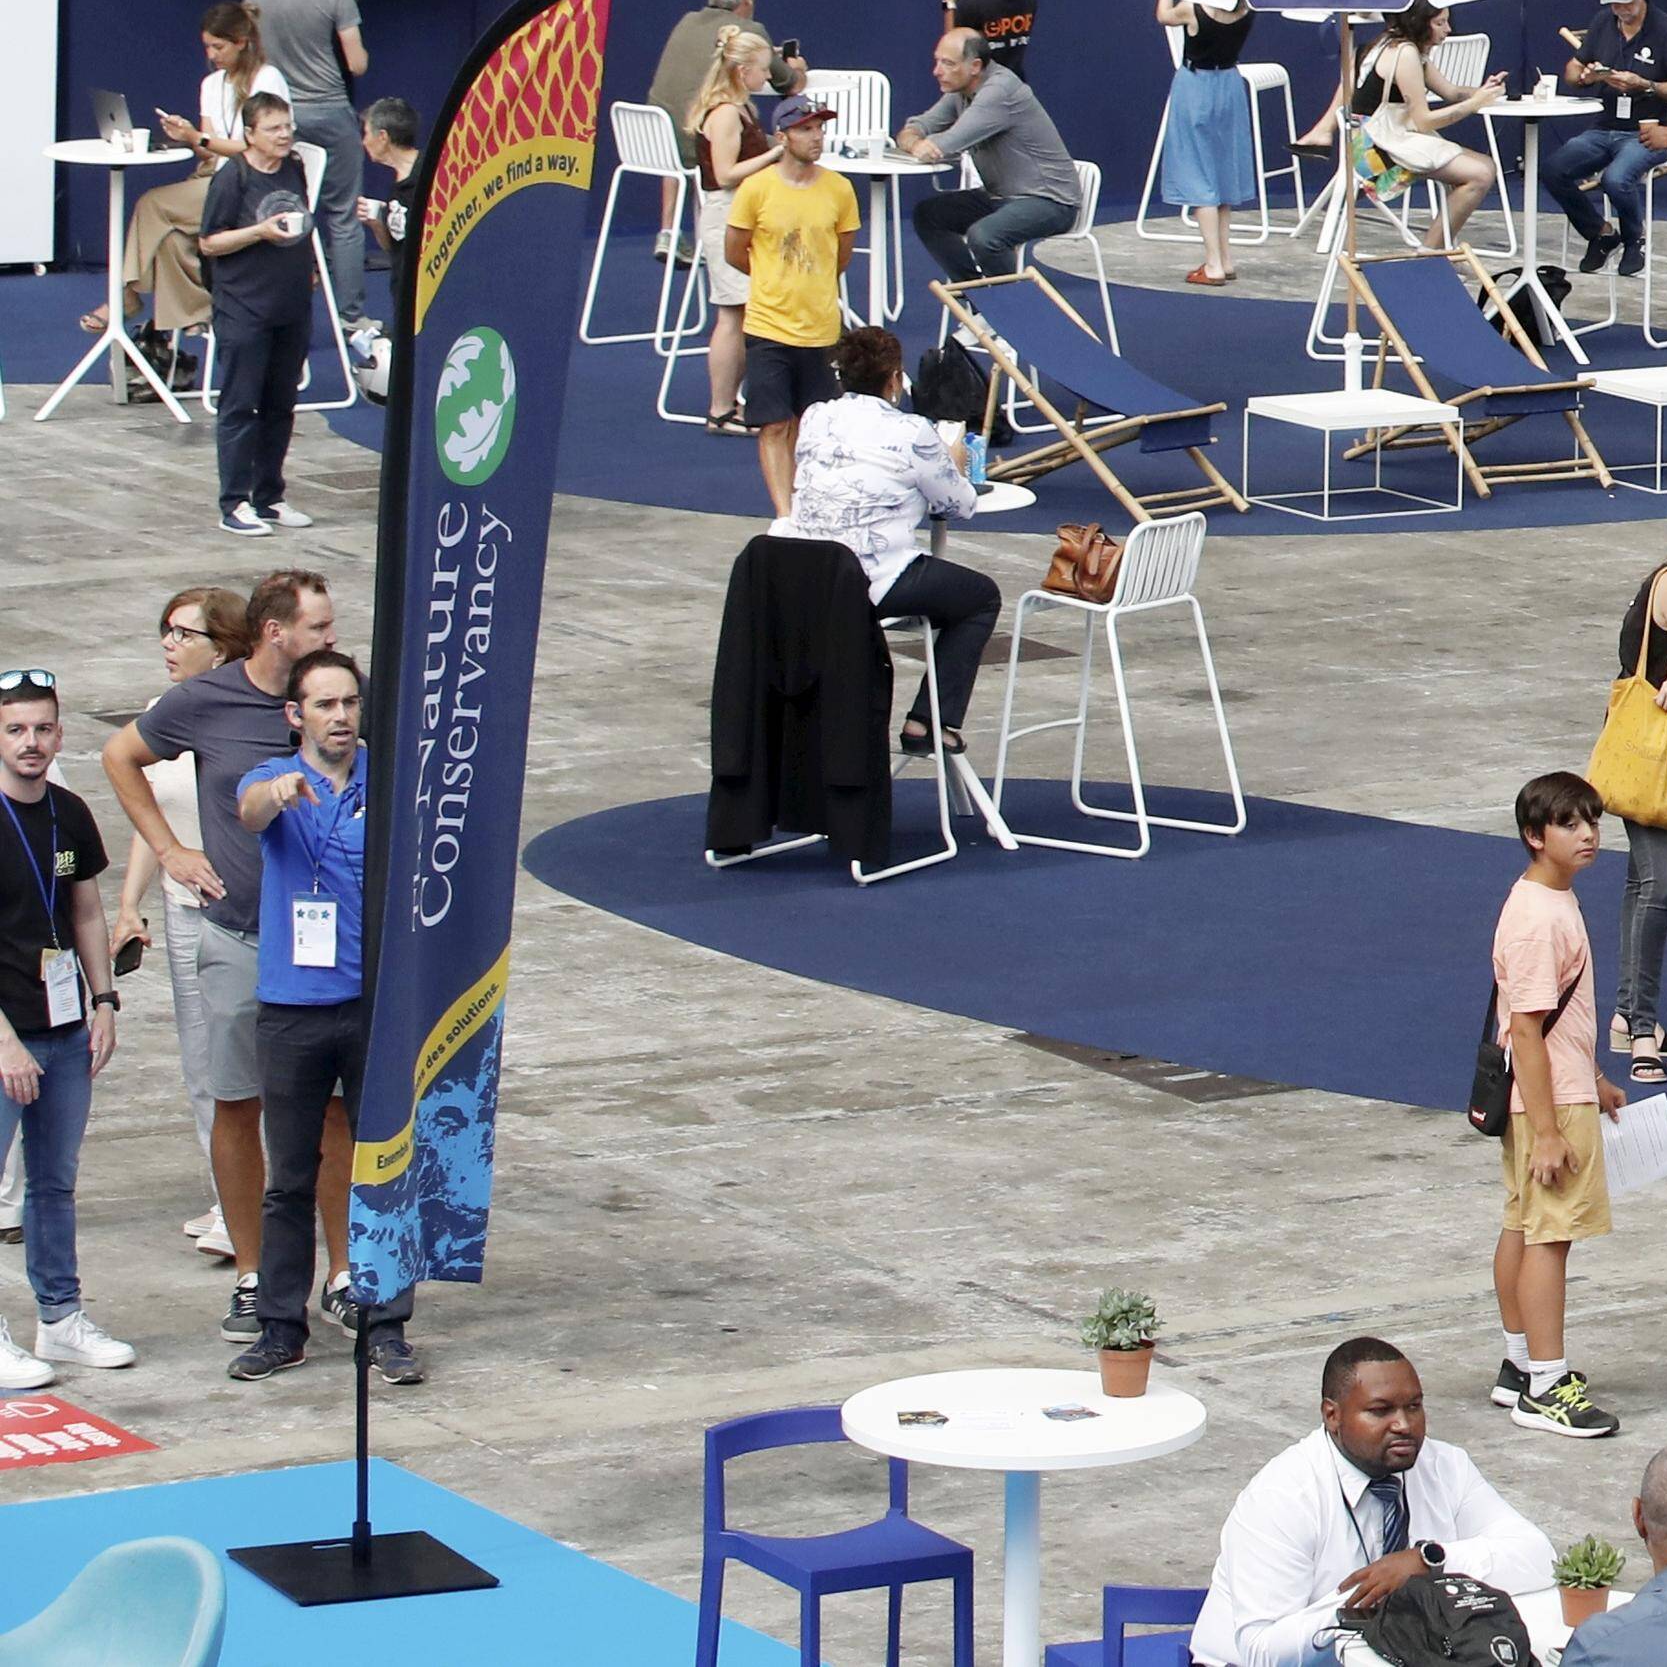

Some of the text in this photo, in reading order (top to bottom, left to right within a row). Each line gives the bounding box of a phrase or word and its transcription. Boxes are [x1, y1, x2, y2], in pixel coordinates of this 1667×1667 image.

[426, 153, 580, 279] Together, we find a way.
[419, 503, 513, 929] Conservancy
[426, 1043, 446, 1070] des
